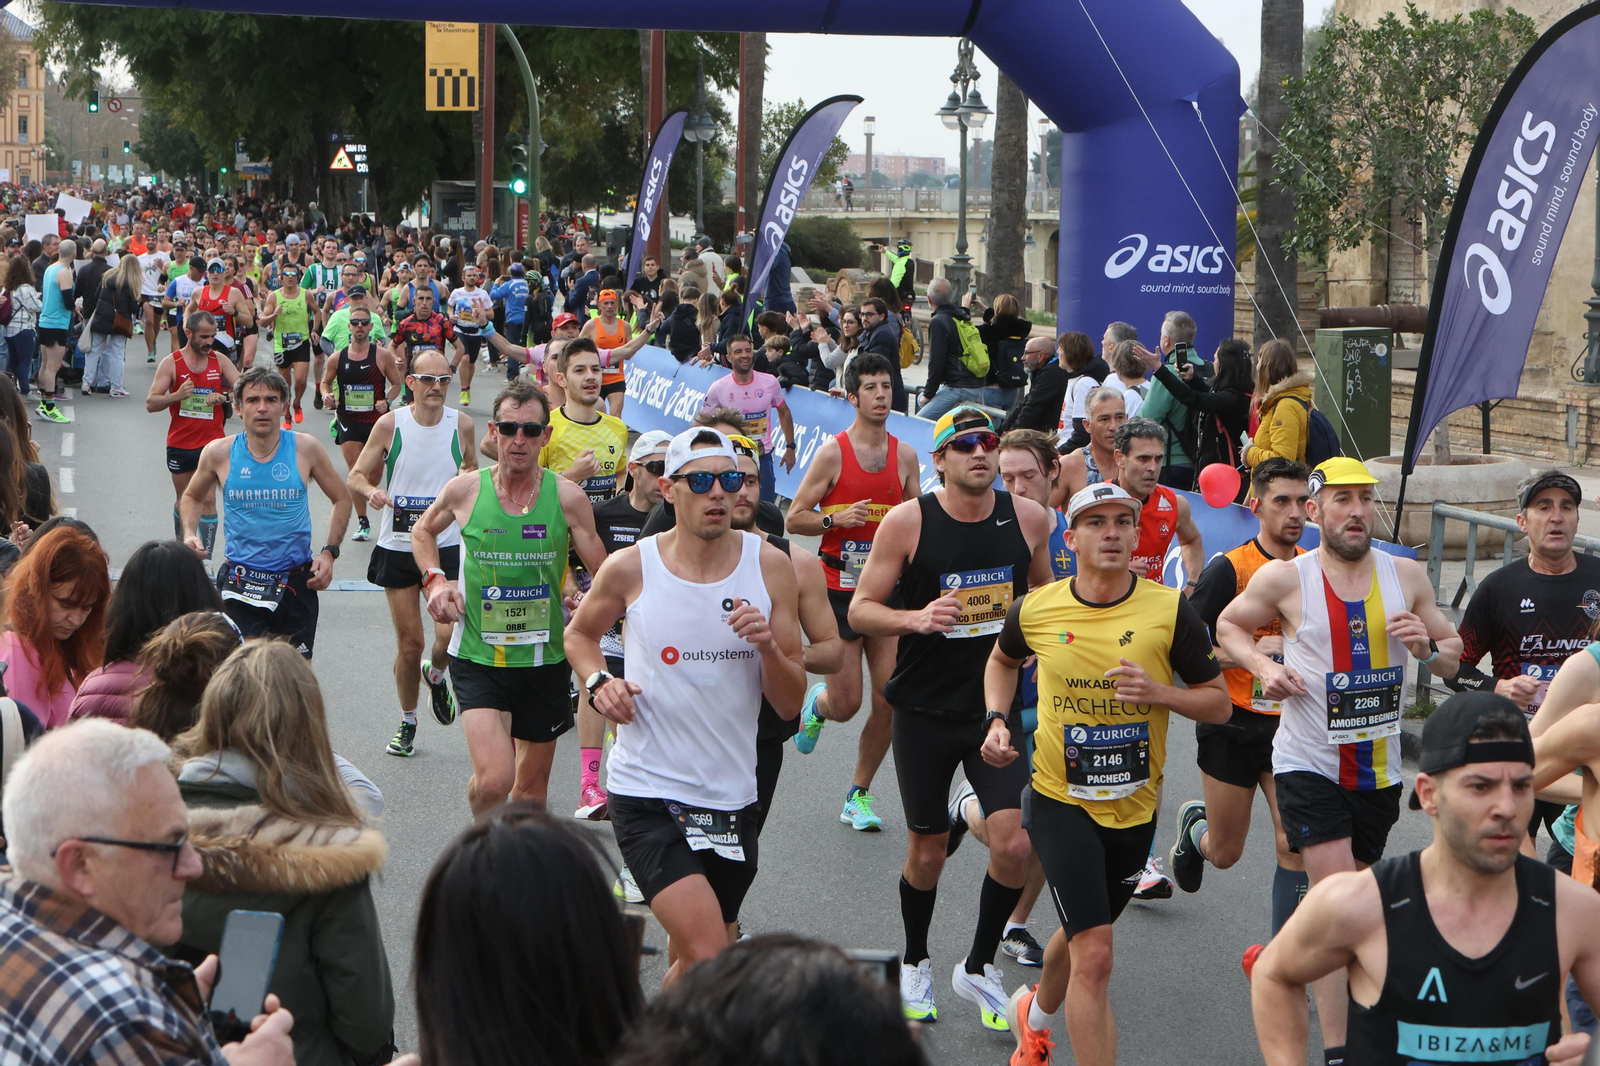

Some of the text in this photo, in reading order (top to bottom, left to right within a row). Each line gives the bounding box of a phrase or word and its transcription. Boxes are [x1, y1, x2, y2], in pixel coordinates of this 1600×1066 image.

[344, 144, 358, 153] SAN
[1531, 101, 1599, 266] sound mind, sound body
[1140, 282, 1232, 297] sound mind, sound body
[193, 387, 213, 395] ZURICH
[603, 461, 615, 470] GO
[590, 477, 614, 487] ZURICH
[473, 550, 557, 560] KRATER RUNNERS
[965, 571, 1005, 585] ZURICH
[505, 587, 543, 598] ZURICH
[966, 594, 991, 607] 4008
[504, 607, 527, 618] 1521
[971, 608, 1007, 622] TEOTONIO
[505, 622, 527, 632] ORBE
[1545, 636, 1592, 651] UNIÓ
[682, 648, 755, 664] outsystems
[1354, 671, 1396, 685] ZURICH
[1053, 695, 1152, 716] PACHECO
[1354, 696, 1380, 710] 2266
[1329, 710, 1399, 729] AMODEO BEGINES
[1092, 726, 1140, 741] ZURICH
[1093, 753, 1123, 767] 2146
[1086, 771, 1131, 785] PACHECO
[1417, 1033, 1533, 1054] IBIZA&ME
